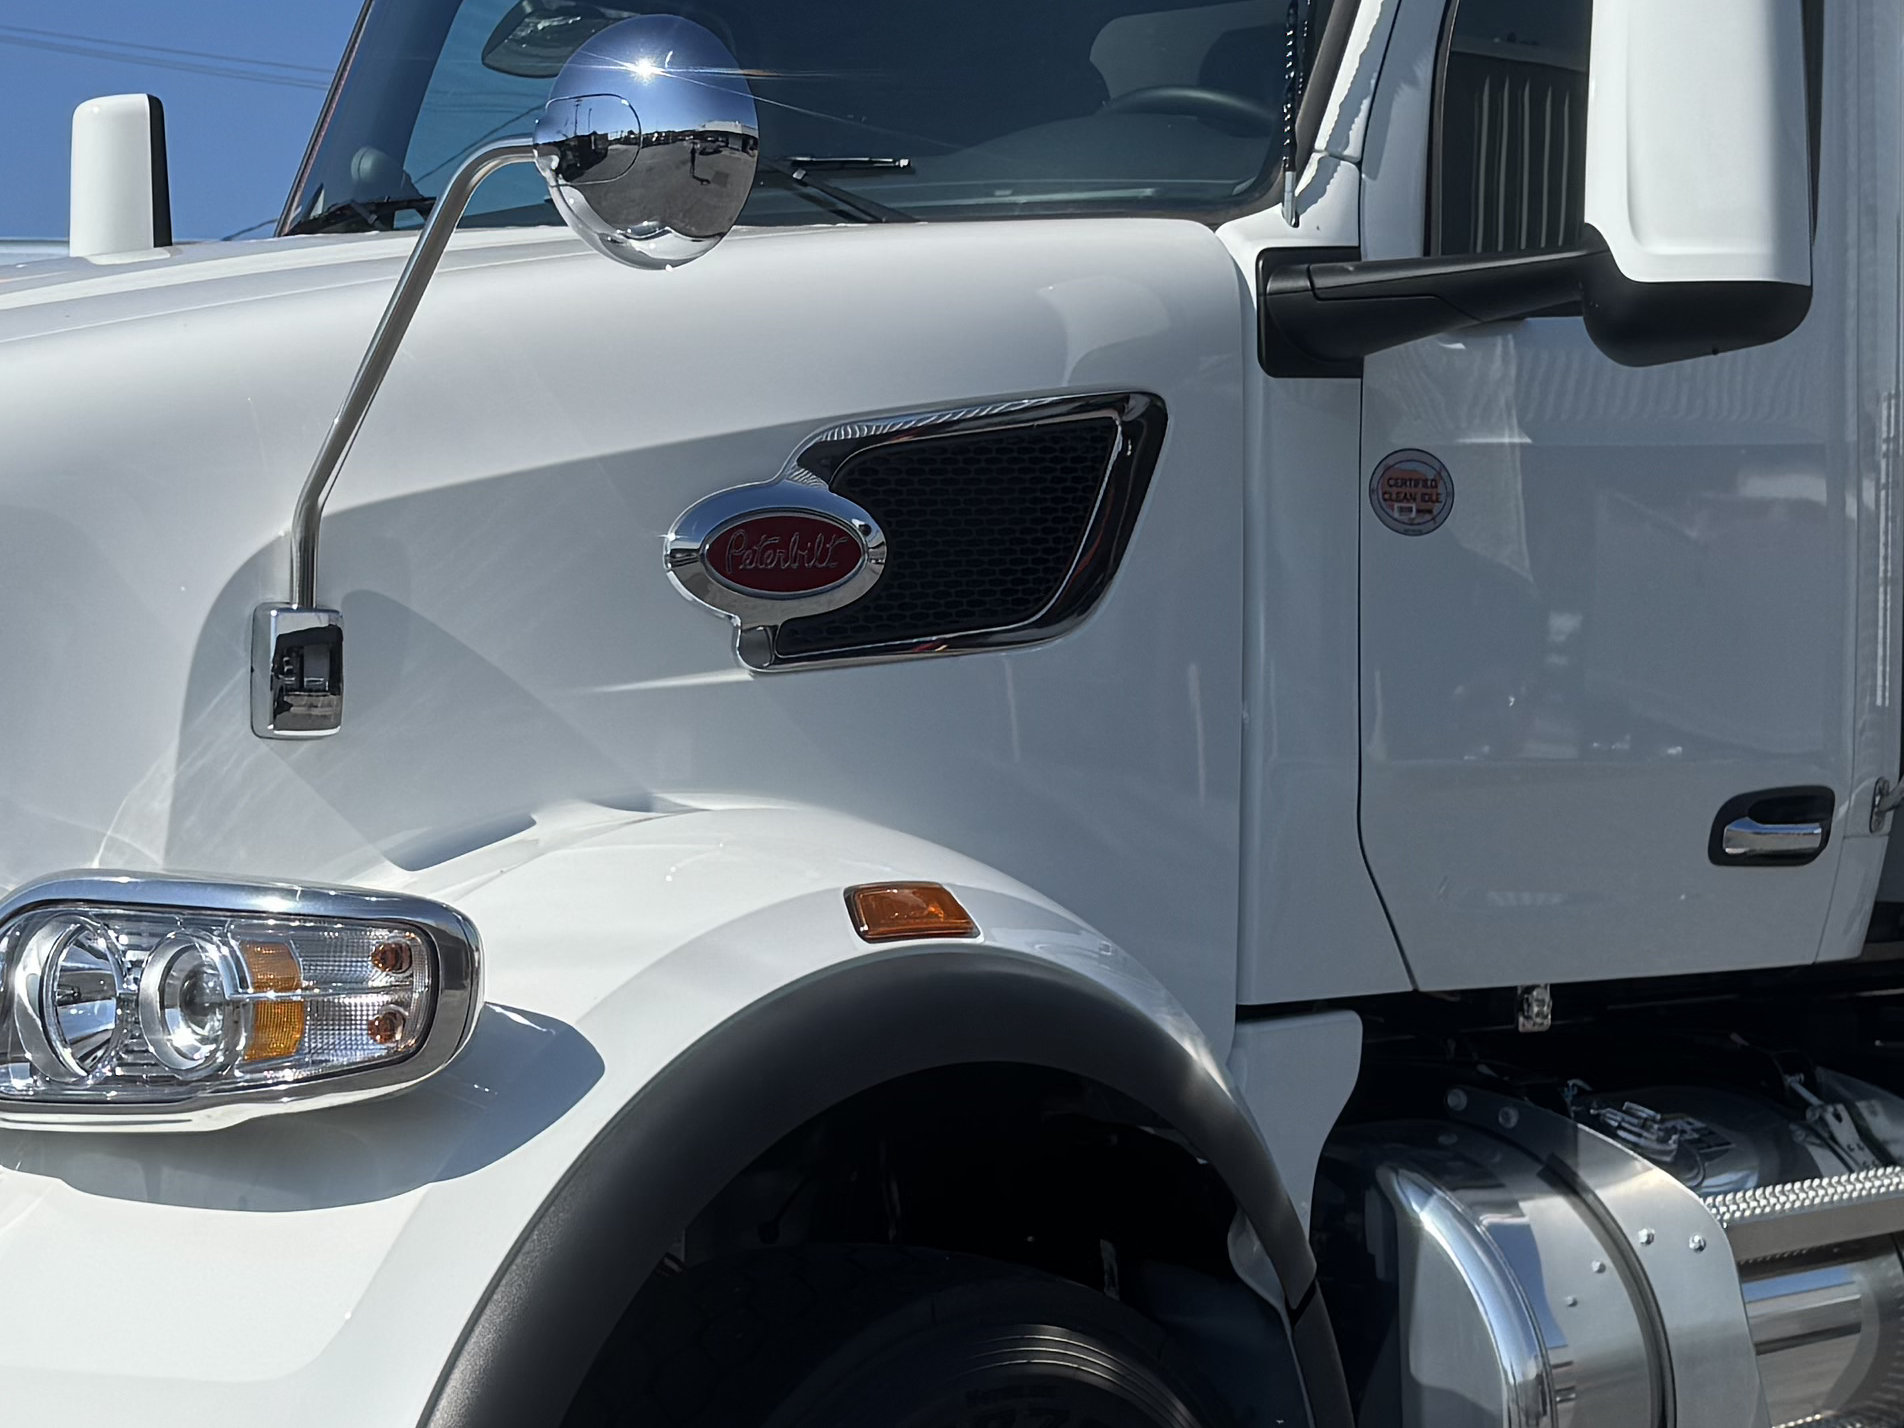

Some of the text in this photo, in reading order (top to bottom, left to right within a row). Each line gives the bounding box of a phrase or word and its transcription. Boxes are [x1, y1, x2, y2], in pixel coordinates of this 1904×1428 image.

[1387, 477, 1438, 489] CERTIFIED
[1382, 491, 1417, 503] CLEAN
[725, 529, 849, 574] Peterbilt
